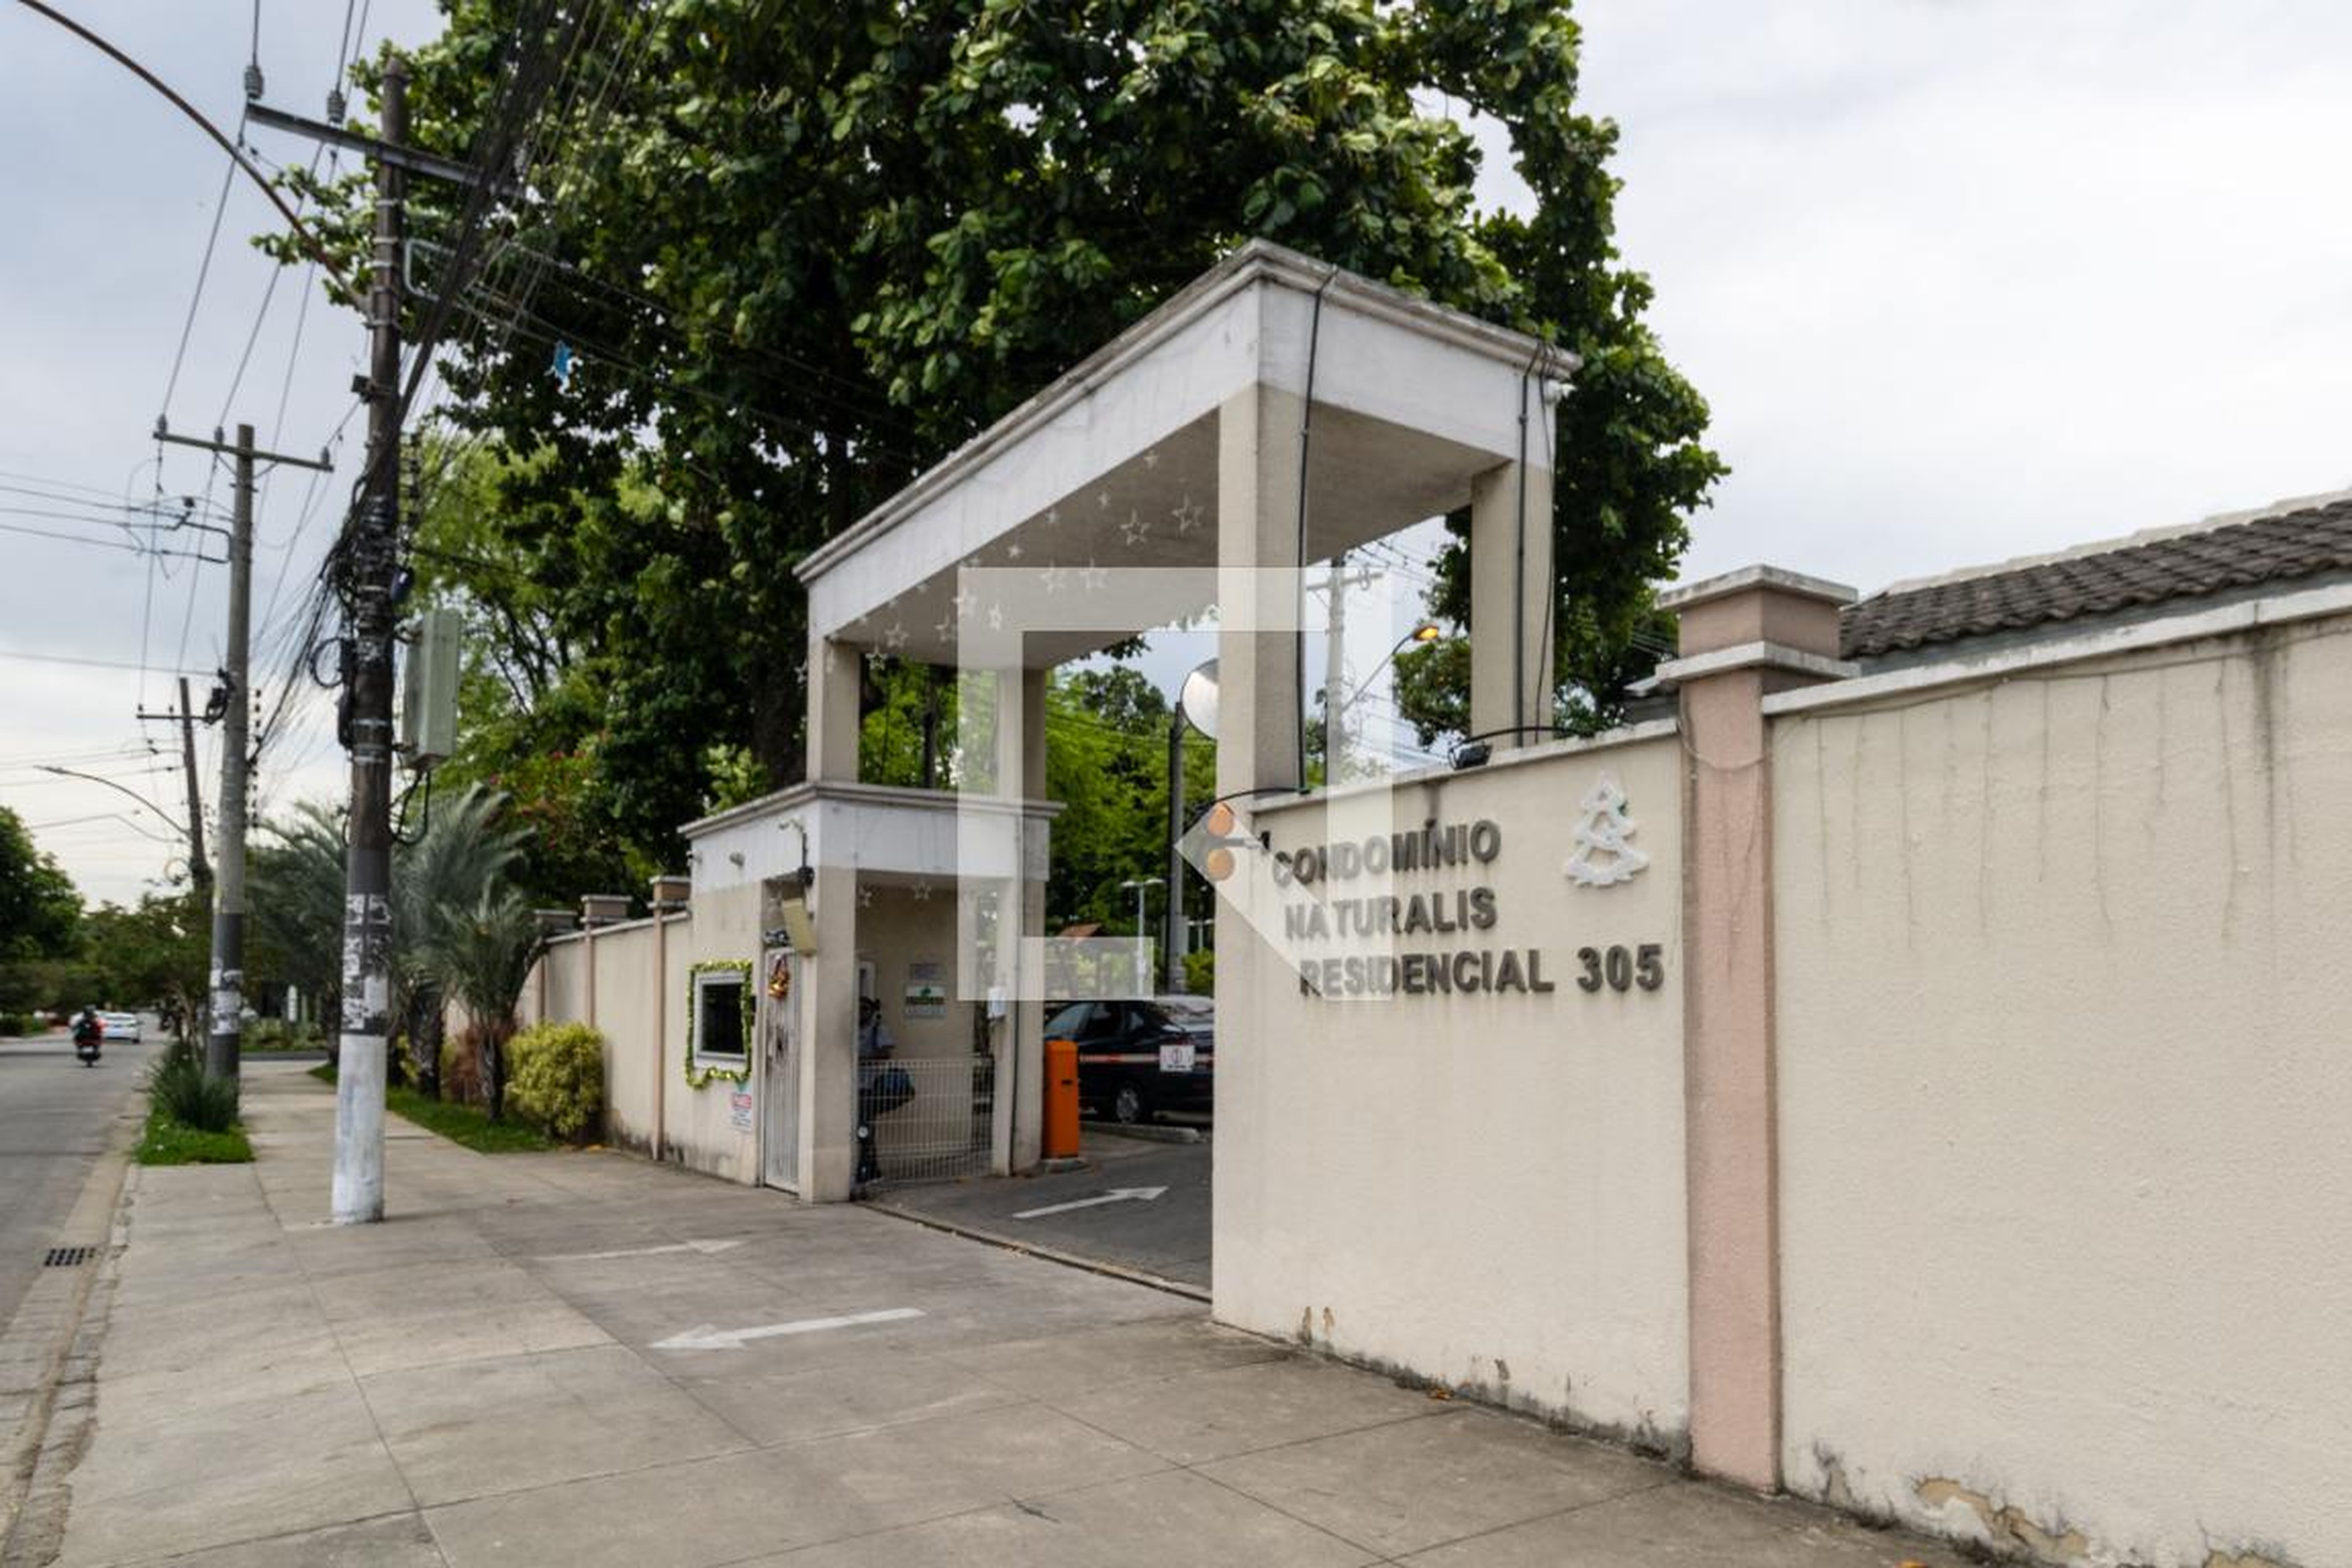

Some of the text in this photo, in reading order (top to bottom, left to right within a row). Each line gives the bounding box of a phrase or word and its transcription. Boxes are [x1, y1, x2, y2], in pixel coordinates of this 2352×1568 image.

[1273, 819, 1501, 888] CONDOMÍNIO
[1285, 887, 1498, 940] NATURALIS
[1300, 944, 1664, 997] RESIDENCIAL 305
